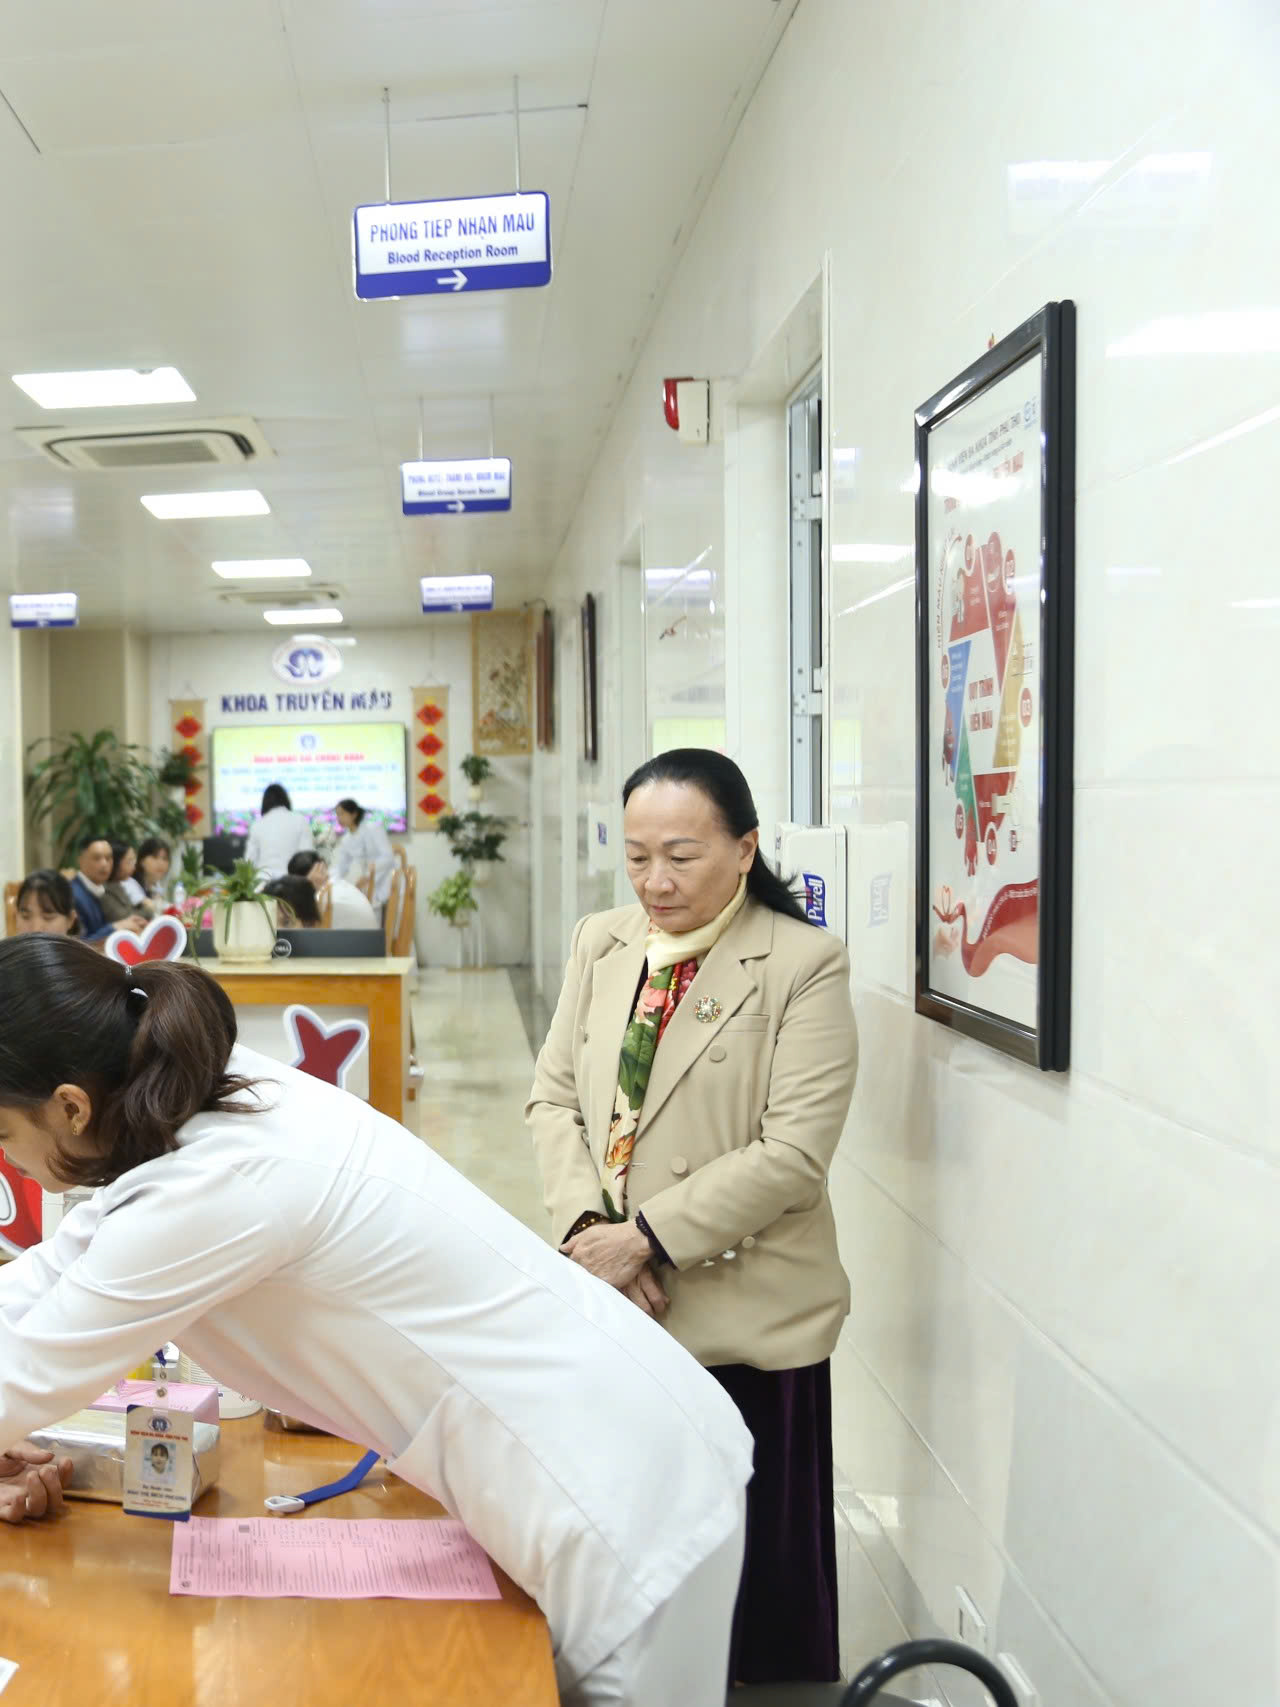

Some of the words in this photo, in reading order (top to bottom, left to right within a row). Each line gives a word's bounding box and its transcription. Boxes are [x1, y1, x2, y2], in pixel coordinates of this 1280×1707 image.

[388, 250, 420, 264] Blood
[424, 247, 482, 263] Reception
[486, 244, 518, 258] Room
[221, 694, 268, 713] KHOA
[807, 878, 823, 921] Purell
